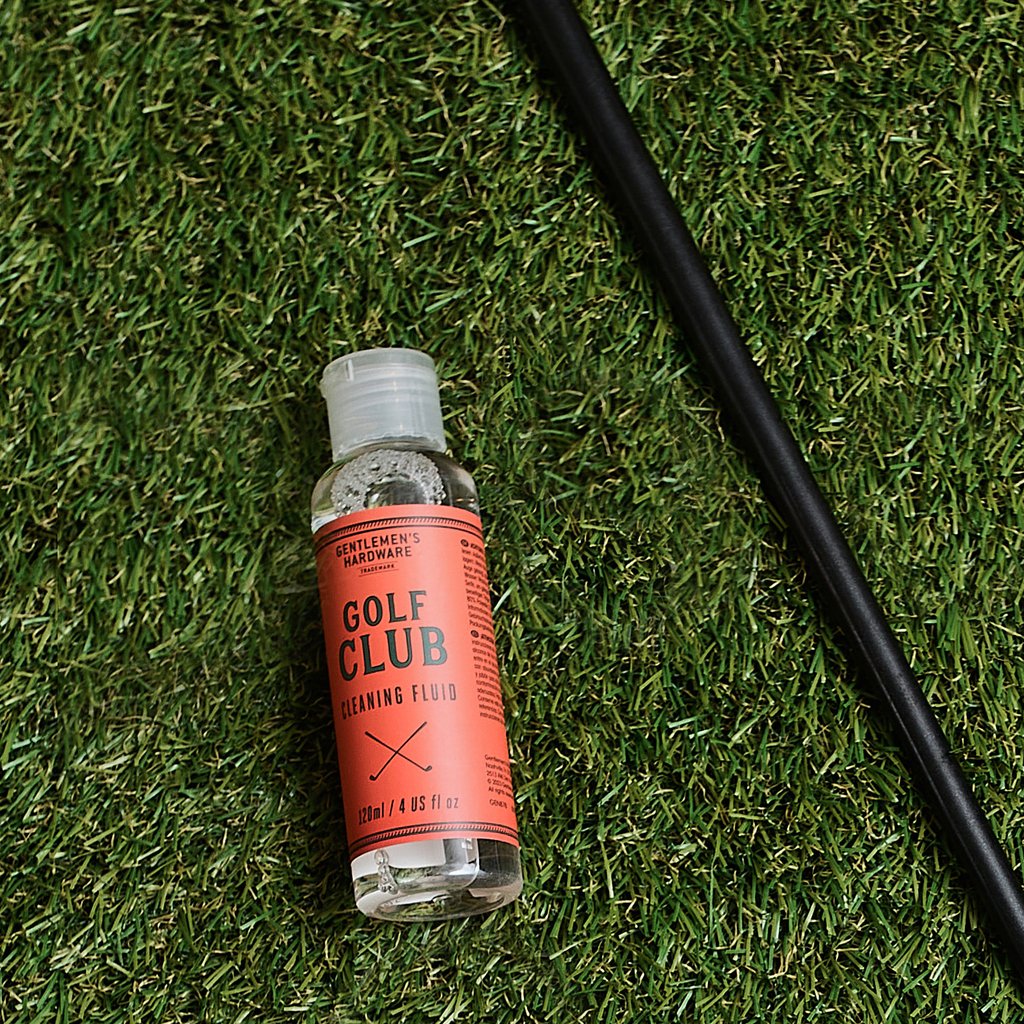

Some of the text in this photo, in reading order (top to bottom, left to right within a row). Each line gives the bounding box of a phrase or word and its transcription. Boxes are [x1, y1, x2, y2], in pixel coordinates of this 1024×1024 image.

[336, 532, 421, 558] GENTLEMEN'S
[343, 545, 413, 569] HARDWARE
[360, 563, 395, 575] TRADEMARK
[343, 590, 428, 632] GOLF
[338, 626, 448, 682] CLUB
[341, 683, 457, 721] CLEANING FLUID
[358, 794, 459, 826] 120ml / 4 US fl oz
